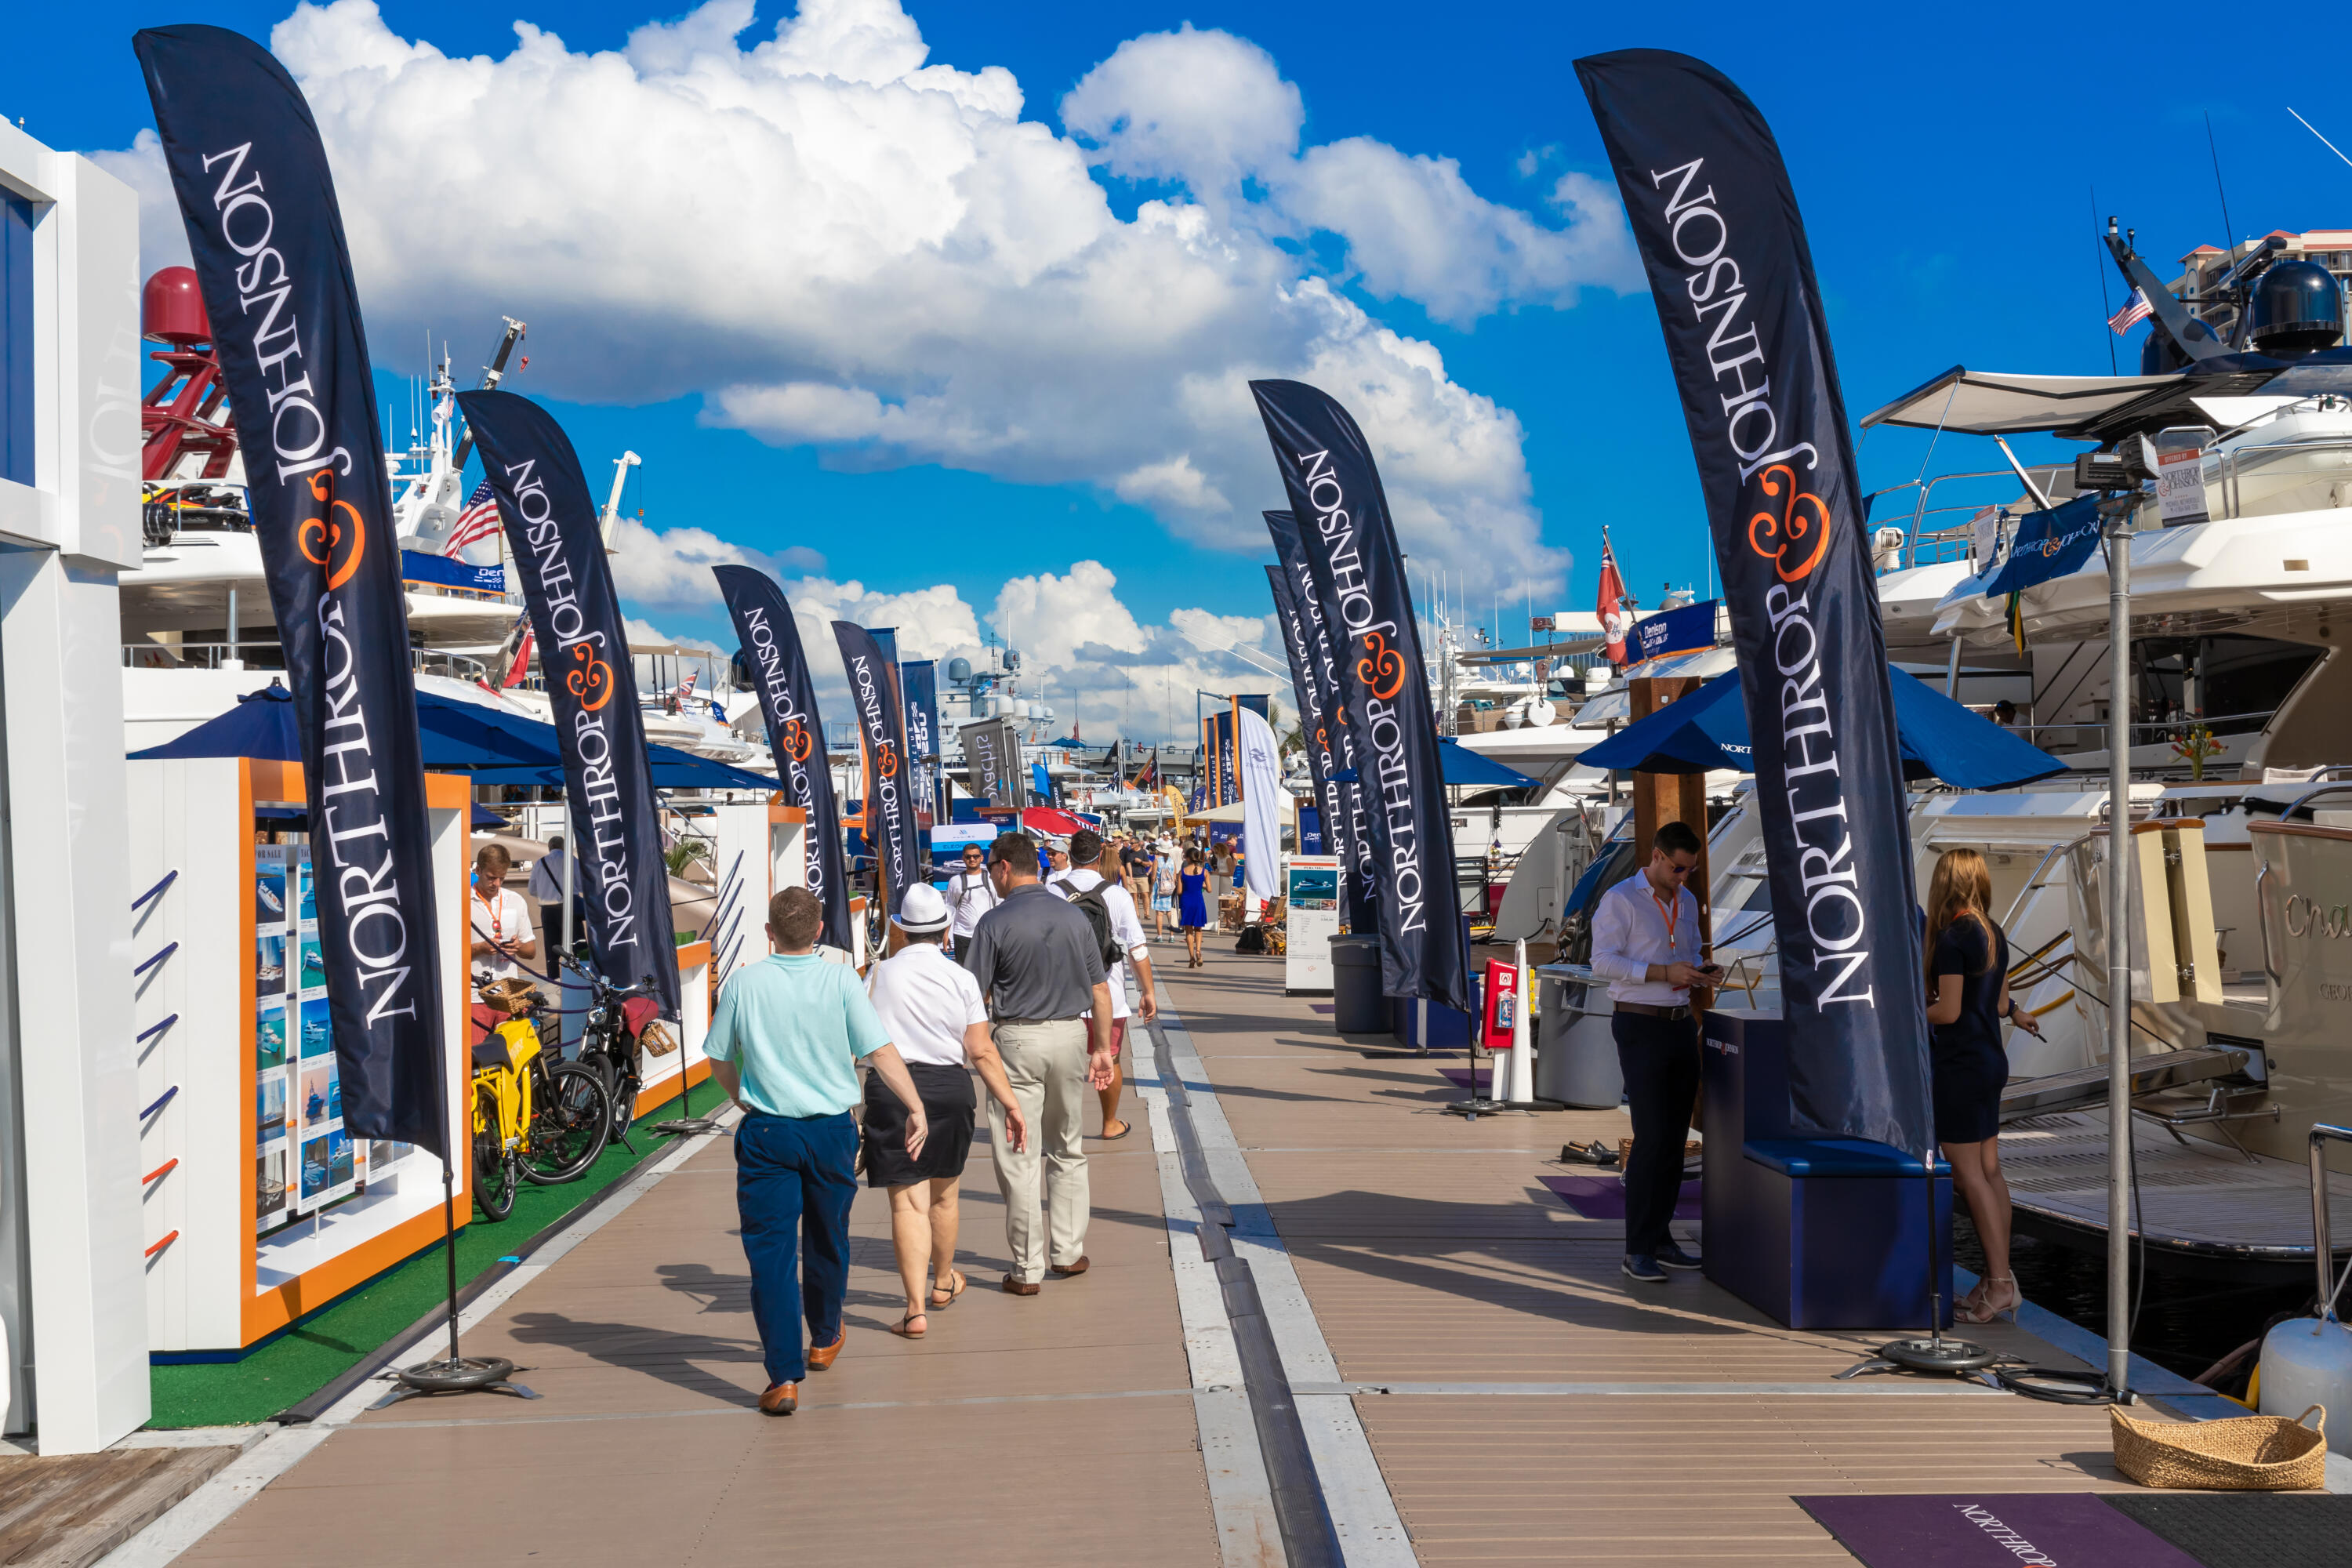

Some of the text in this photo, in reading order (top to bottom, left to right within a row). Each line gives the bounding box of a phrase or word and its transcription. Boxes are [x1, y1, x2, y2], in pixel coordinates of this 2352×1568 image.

[203, 142, 352, 486] JOHNSON
[2161, 466, 2199, 481] NORTHROP
[2169, 477, 2199, 495] JOHNSON
[1651, 158, 1876, 1014] NORTHROP & JOHNSON
[2010, 539, 2049, 558] NRTHROP
[744, 607, 807, 726] JOHNSON
[1645, 623, 1667, 638] Denison
[505, 459, 638, 951] NORTHROP & JOHNSON
[852, 655, 894, 748] JOHNSON
[1298, 449, 1426, 937] NORTHROP & JOHNSON
[1721, 743, 1751, 753] NORT
[318, 592, 416, 1030] NORTHROP
[880, 775, 903, 890] NORTHROP
[1952, 1504, 2057, 1567] NORTHROP
